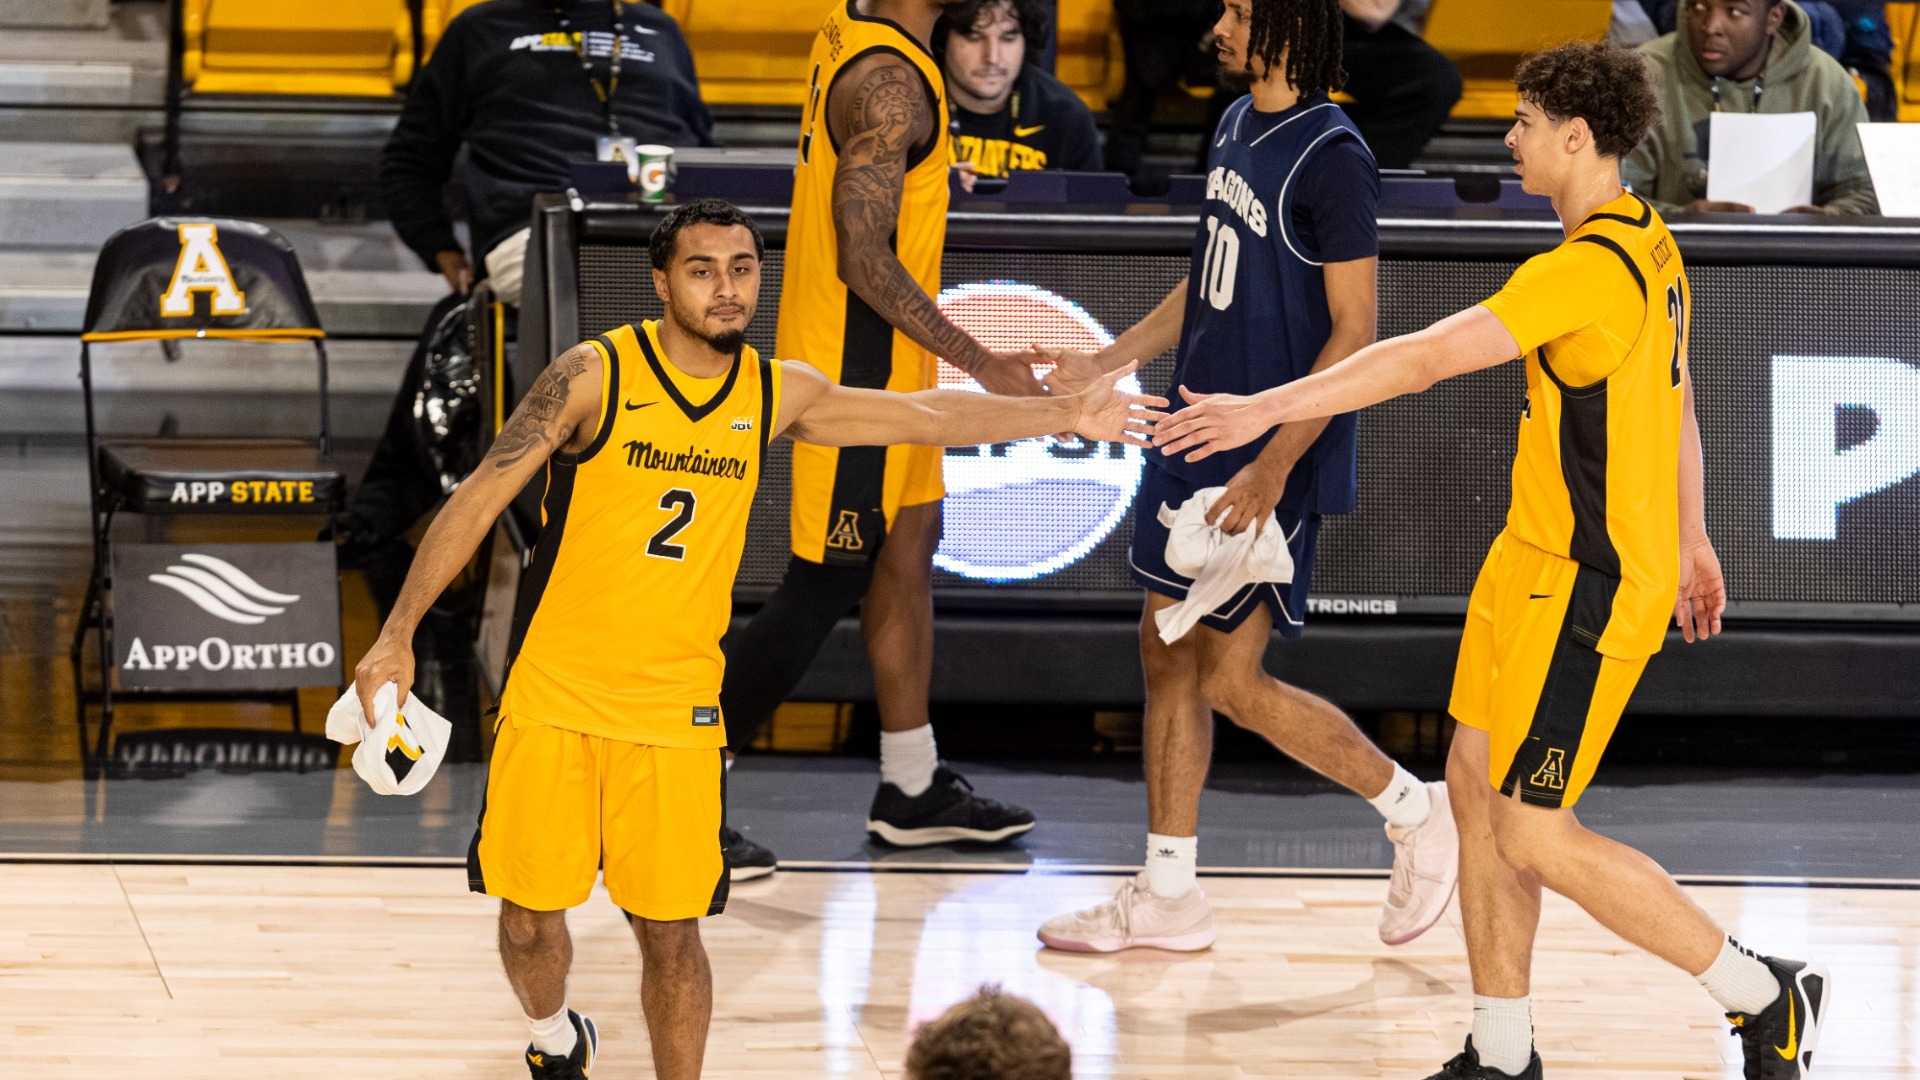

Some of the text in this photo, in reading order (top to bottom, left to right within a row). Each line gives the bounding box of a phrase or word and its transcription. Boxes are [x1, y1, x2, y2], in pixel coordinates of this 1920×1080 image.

[641, 160, 666, 193] G
[160, 223, 245, 317] A
[1200, 215, 1240, 311] 10
[622, 440, 747, 481] Mountaineers
[1772, 355, 1920, 541] P
[170, 480, 315, 503] APP STATE
[645, 487, 698, 562] 2
[827, 509, 864, 550] A
[1306, 598, 1398, 615] TRONICS
[1530, 747, 1565, 789] A
